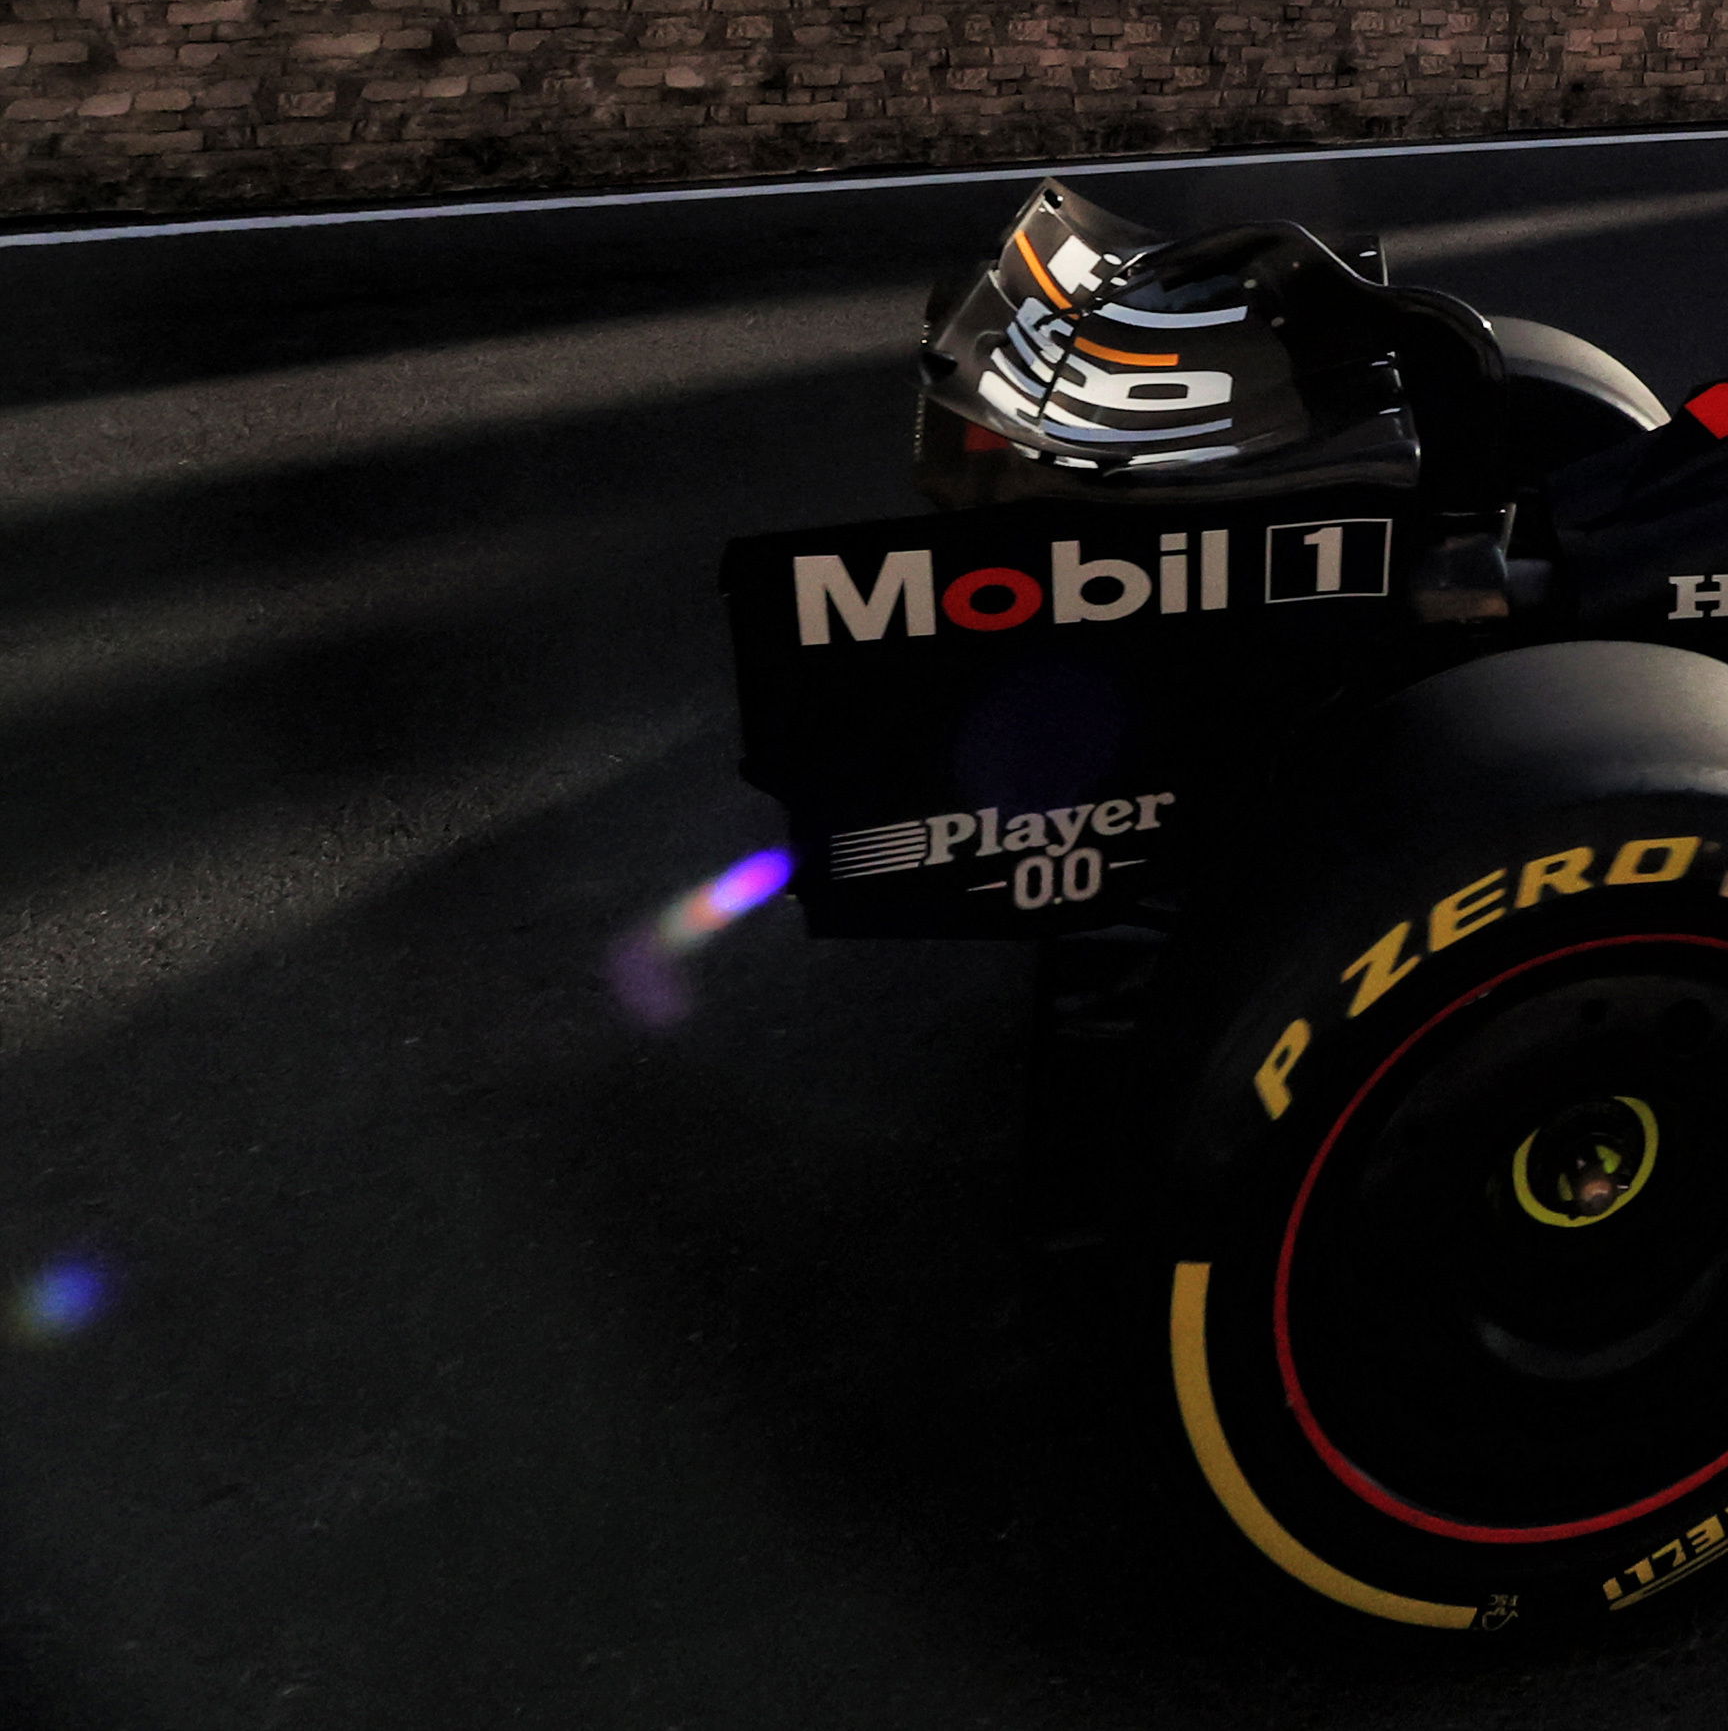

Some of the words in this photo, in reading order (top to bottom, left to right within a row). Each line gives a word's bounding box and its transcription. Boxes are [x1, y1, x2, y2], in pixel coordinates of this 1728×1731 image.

[793, 528, 1229, 646] Mobil
[1303, 527, 1343, 592] 1
[923, 792, 1176, 867] Player
[1014, 847, 1103, 910] 0.0
[1254, 1017, 1312, 1122] P
[1341, 832, 1701, 1020] ZERO
